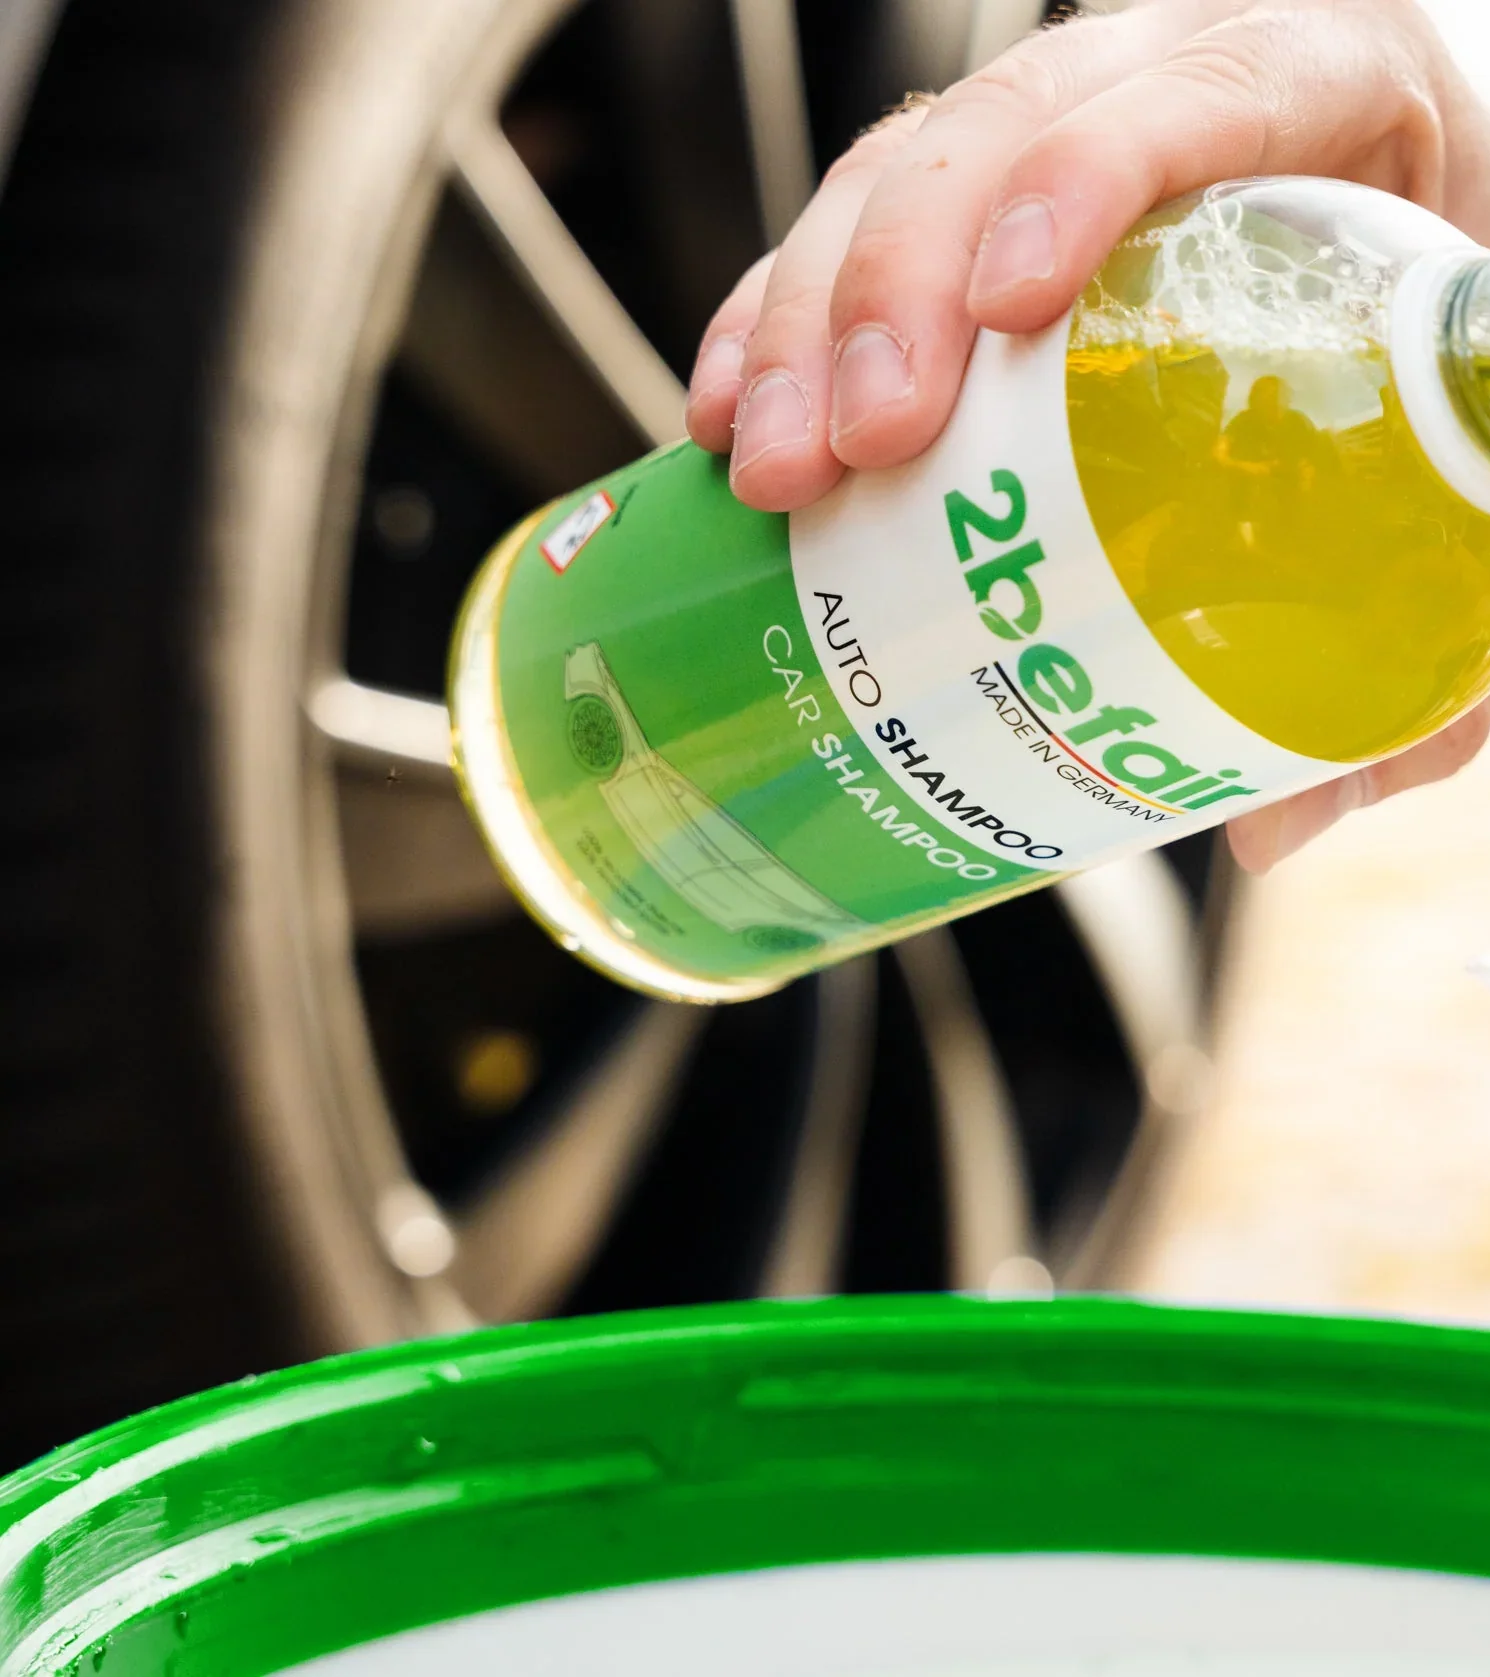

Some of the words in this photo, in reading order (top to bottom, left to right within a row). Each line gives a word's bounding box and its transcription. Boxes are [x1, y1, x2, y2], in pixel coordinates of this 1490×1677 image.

[762, 624, 822, 727] CAR
[811, 732, 998, 881] SHAMPOO
[813, 591, 882, 708] AUTO
[875, 717, 1064, 860] SHAMPOO
[944, 468, 1262, 811] 2befair
[970, 666, 1037, 740] MADE
[1028, 739, 1061, 763] IN
[1056, 763, 1177, 824] GERMANY
